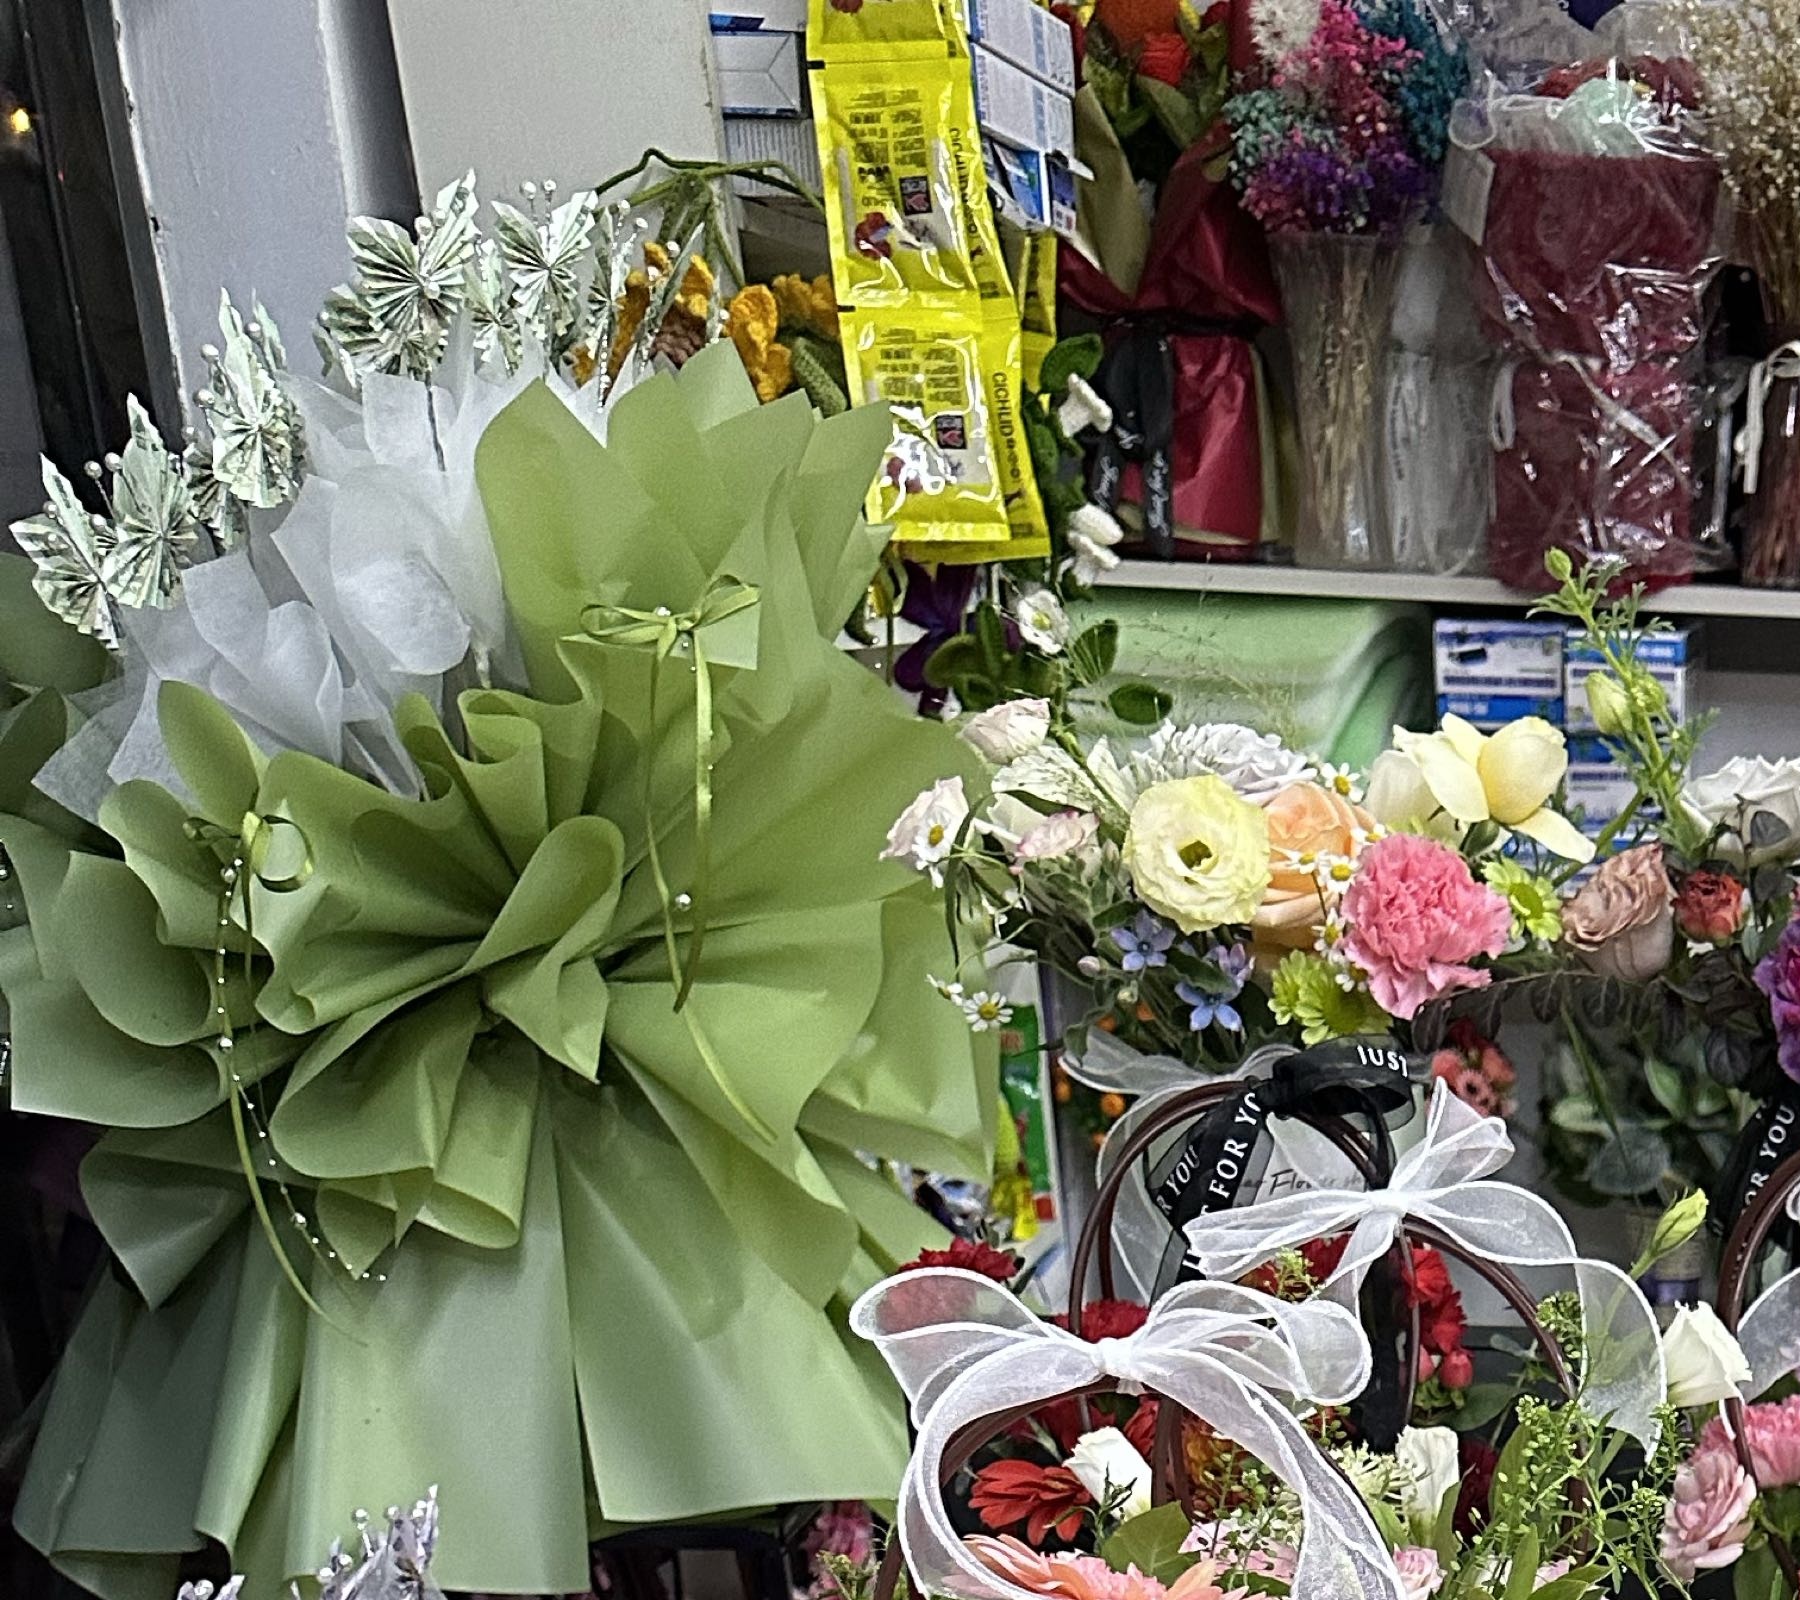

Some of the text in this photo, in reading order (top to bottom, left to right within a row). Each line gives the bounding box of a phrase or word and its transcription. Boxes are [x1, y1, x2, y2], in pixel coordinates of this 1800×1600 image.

[992, 372, 1014, 437] CICHLID
[1759, 1105, 1795, 1158] YOU
[1208, 1138, 1248, 1198] FOR
